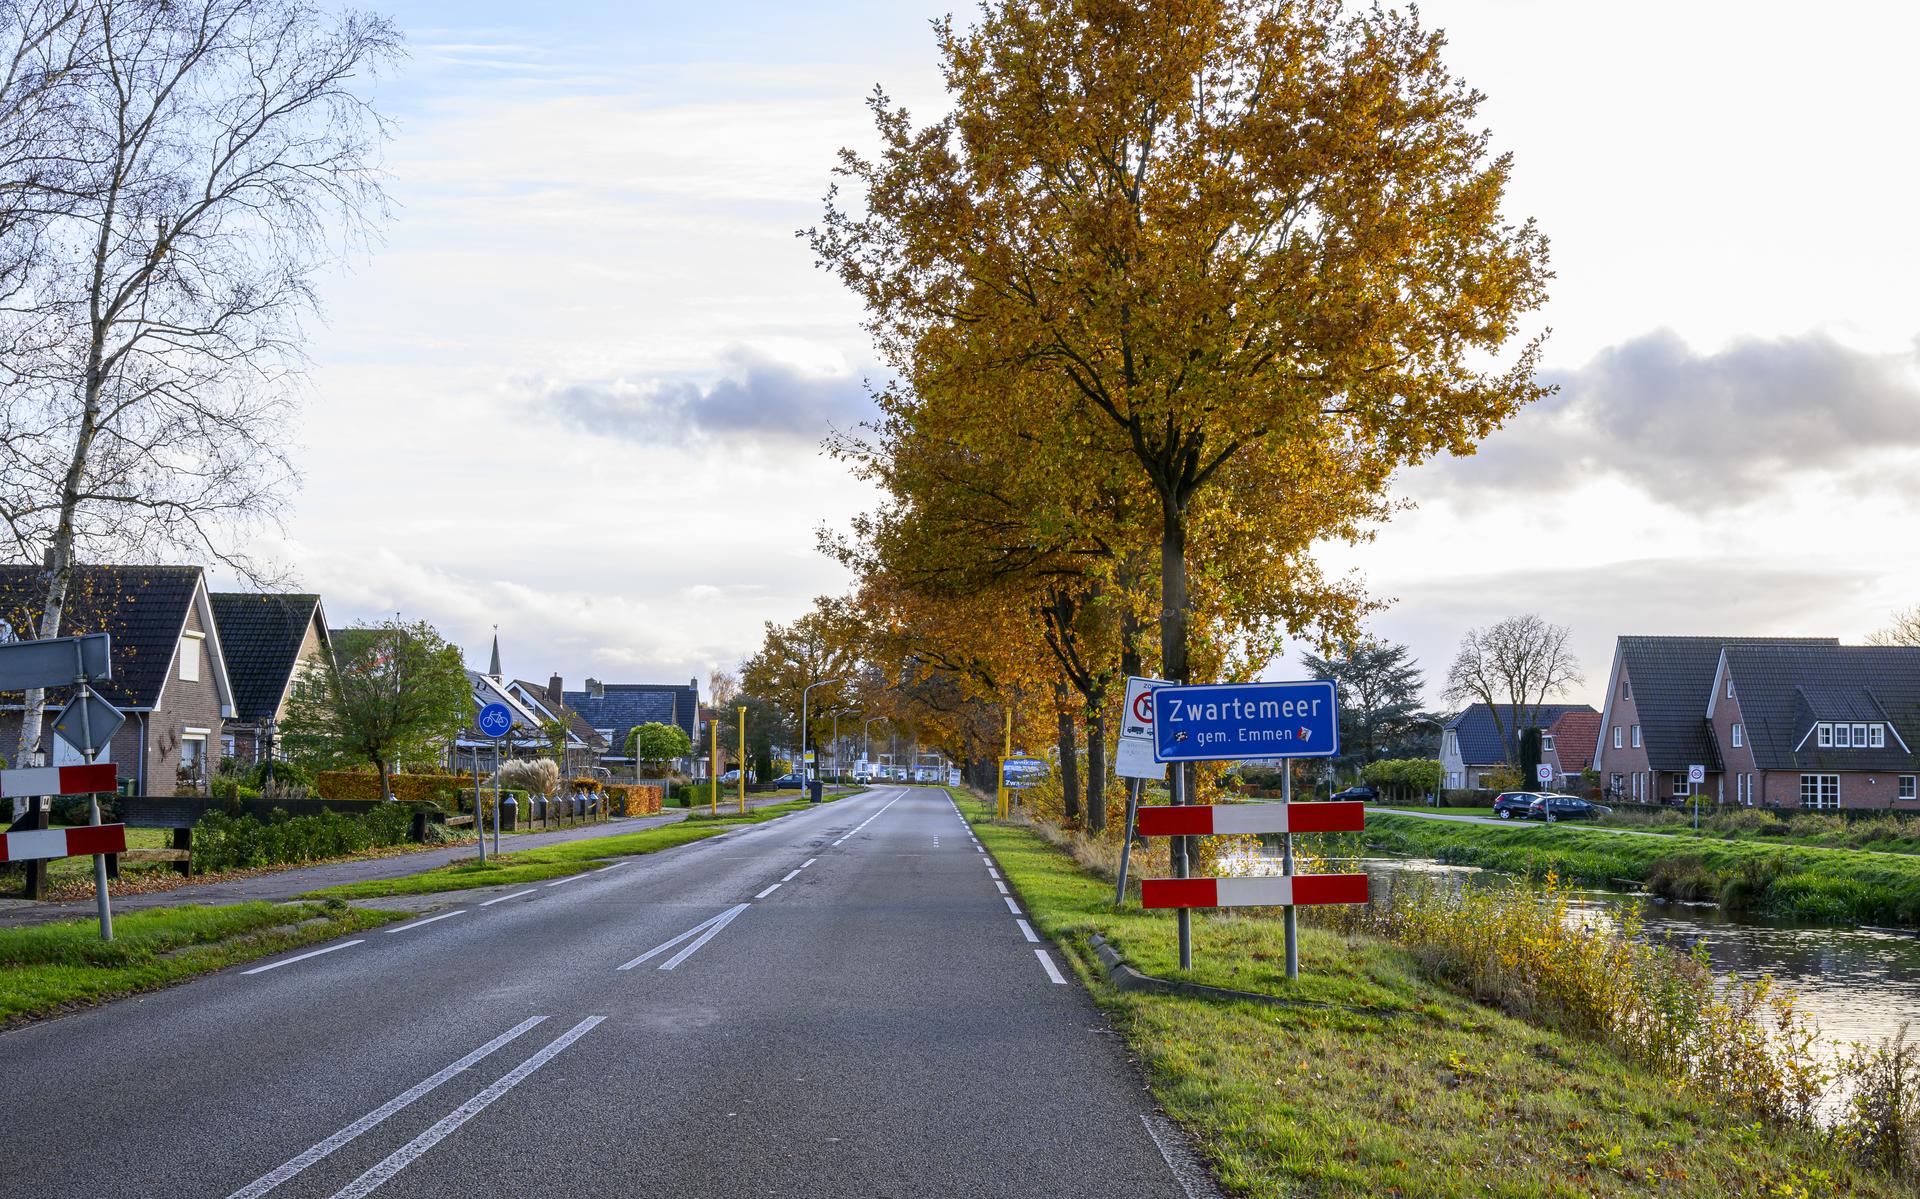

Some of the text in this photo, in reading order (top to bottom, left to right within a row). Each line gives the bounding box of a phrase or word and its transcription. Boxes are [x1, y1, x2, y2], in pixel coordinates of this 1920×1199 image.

[1169, 698, 1321, 722] Zwartemeer
[1197, 728, 1292, 747] gem. Emmen
